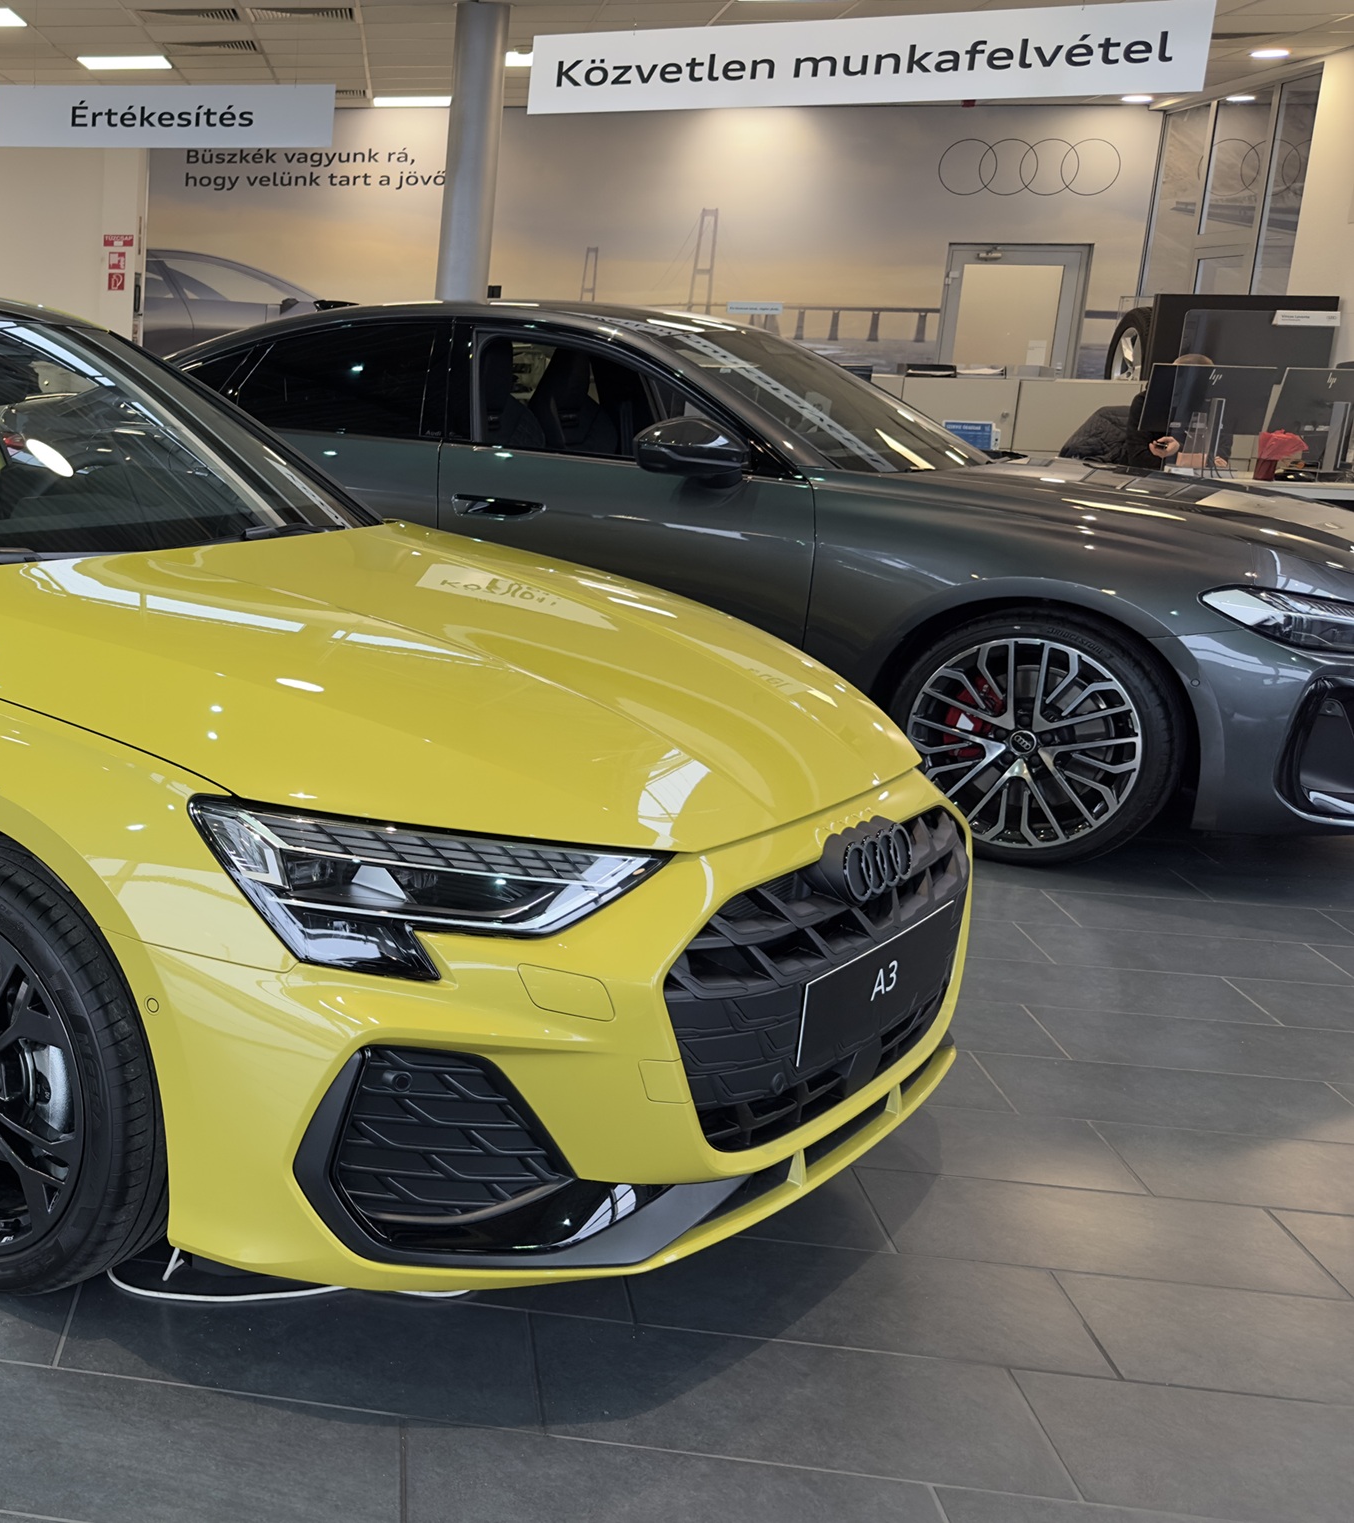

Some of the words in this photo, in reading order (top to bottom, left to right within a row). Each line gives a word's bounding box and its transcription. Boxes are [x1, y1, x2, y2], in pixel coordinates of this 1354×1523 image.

[556, 53, 776, 88] Közvetlen
[792, 31, 1173, 79] munkafelvétel
[71, 100, 254, 128] Értékesítés
[186, 149, 277, 164] Büszkék
[284, 148, 379, 167] vagyunk
[387, 147, 415, 165] rá,
[185, 172, 240, 191] hogy
[246, 171, 321, 187] velünk
[328, 173, 371, 186] tart
[378, 175, 391, 186] a
[870, 960, 898, 1001] A3
